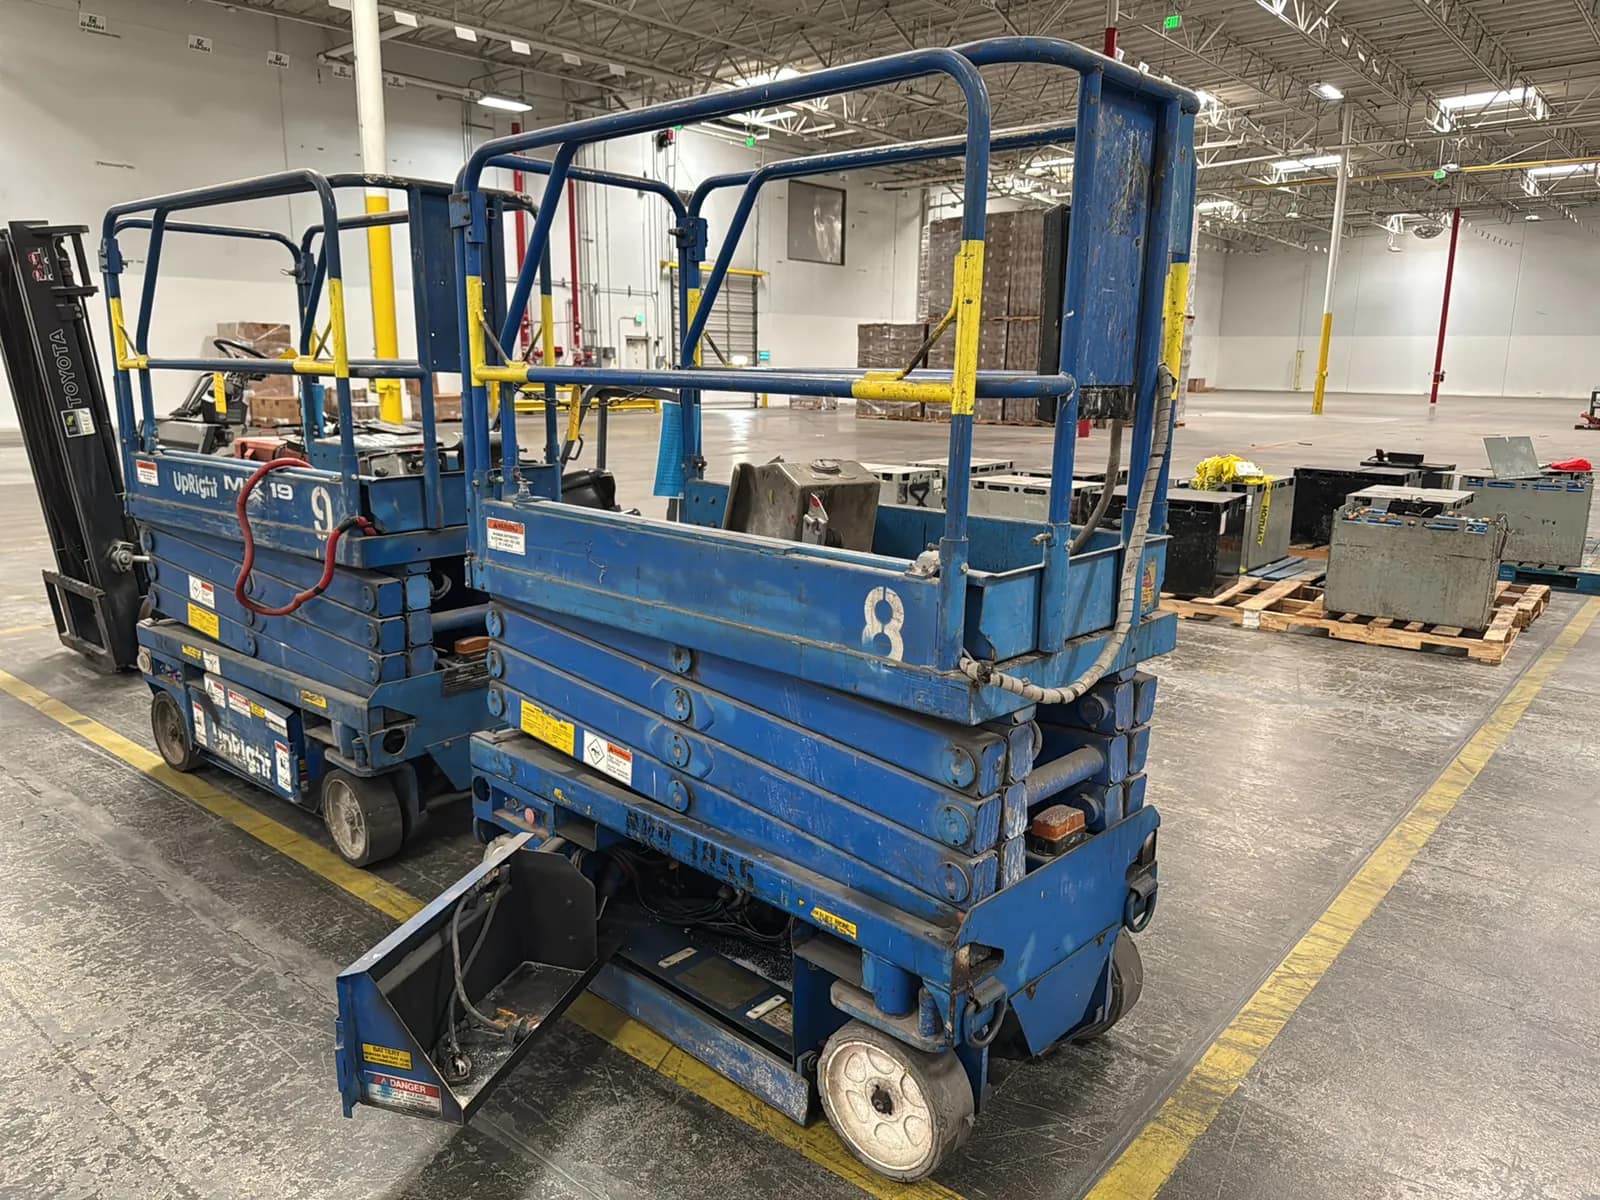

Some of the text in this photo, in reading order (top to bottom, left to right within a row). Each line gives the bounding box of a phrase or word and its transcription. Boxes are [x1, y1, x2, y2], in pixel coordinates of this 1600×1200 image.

[50, 328, 82, 409] TOYOTA
[270, 482, 294, 501] 19
[311, 486, 334, 541] 9
[1257, 504, 1269, 543] CAUTION
[861, 586, 905, 667] 8
[389, 1079, 427, 1094] DANGER
